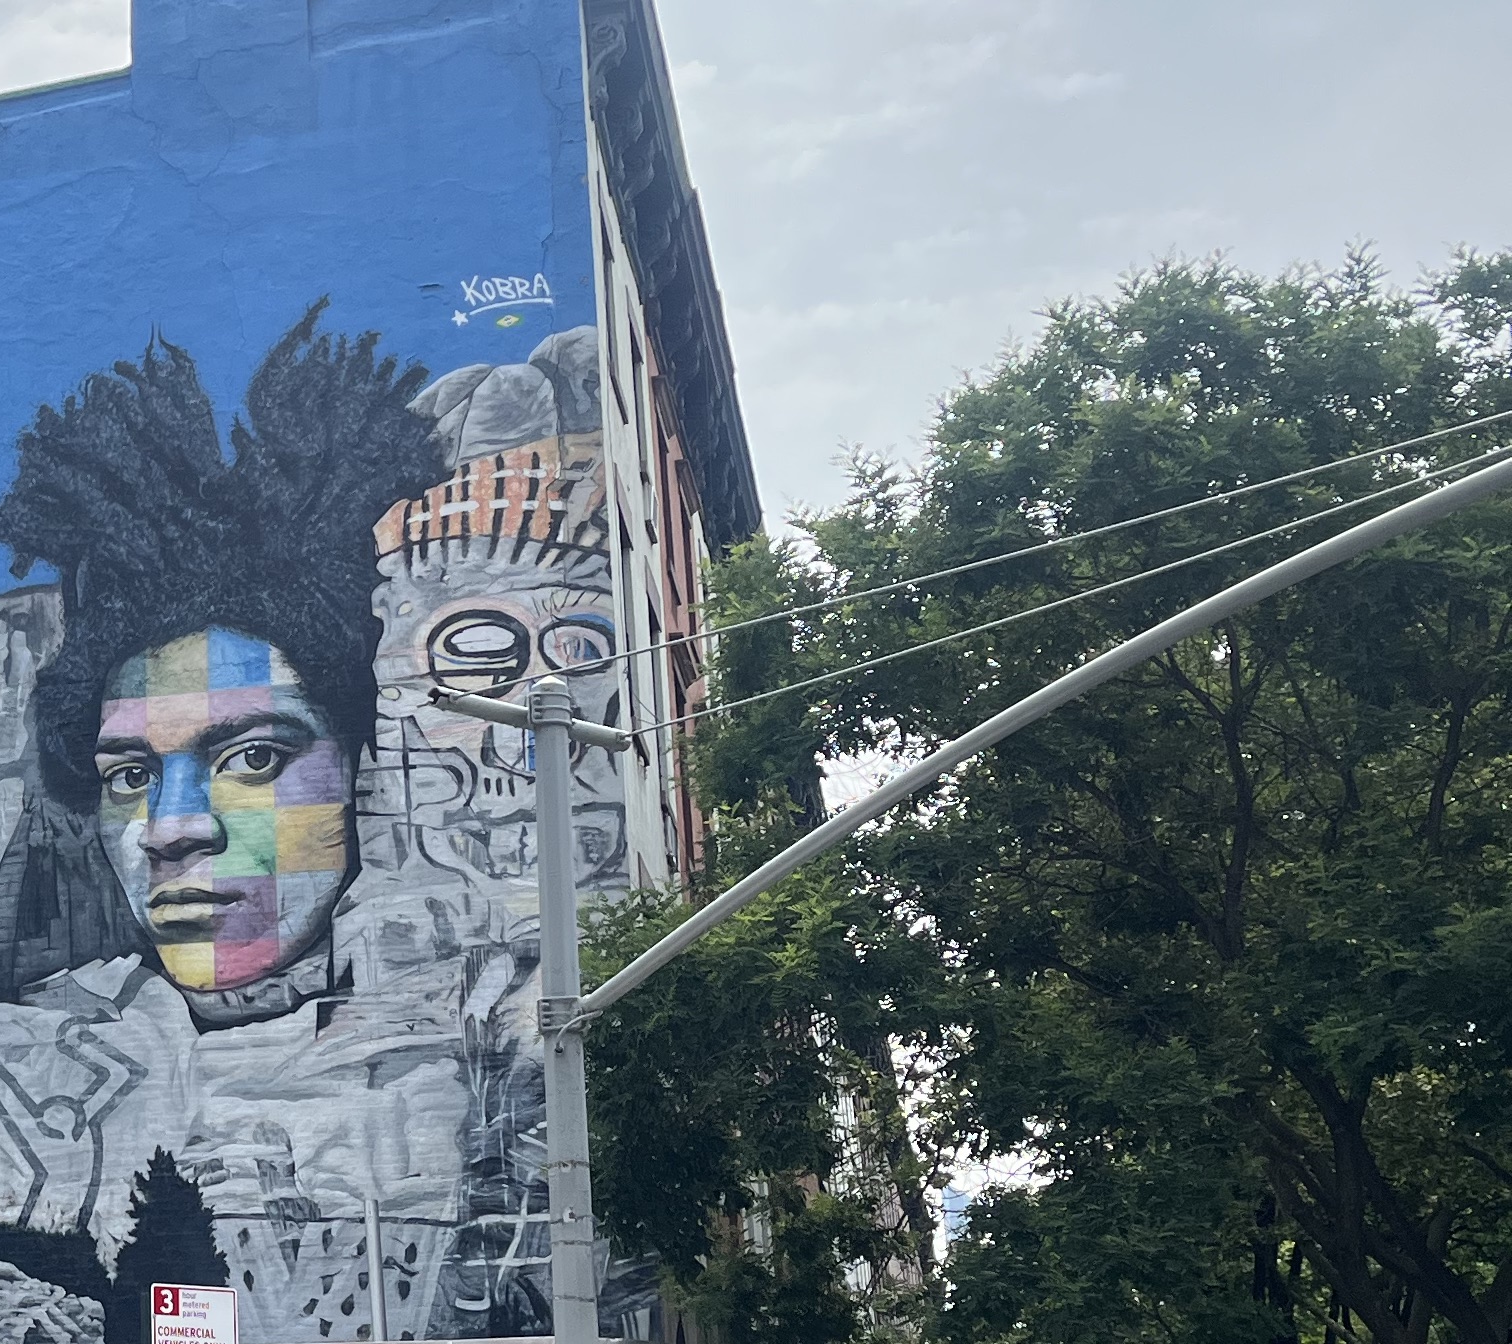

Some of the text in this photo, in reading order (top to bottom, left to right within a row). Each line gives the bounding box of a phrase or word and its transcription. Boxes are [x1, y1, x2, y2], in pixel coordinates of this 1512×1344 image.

[460, 272, 550, 306] KOBRA
[159, 1289, 174, 1314] 3
[182, 1301, 210, 1309] metered
[157, 1326, 216, 1339] COMMERCIAL
